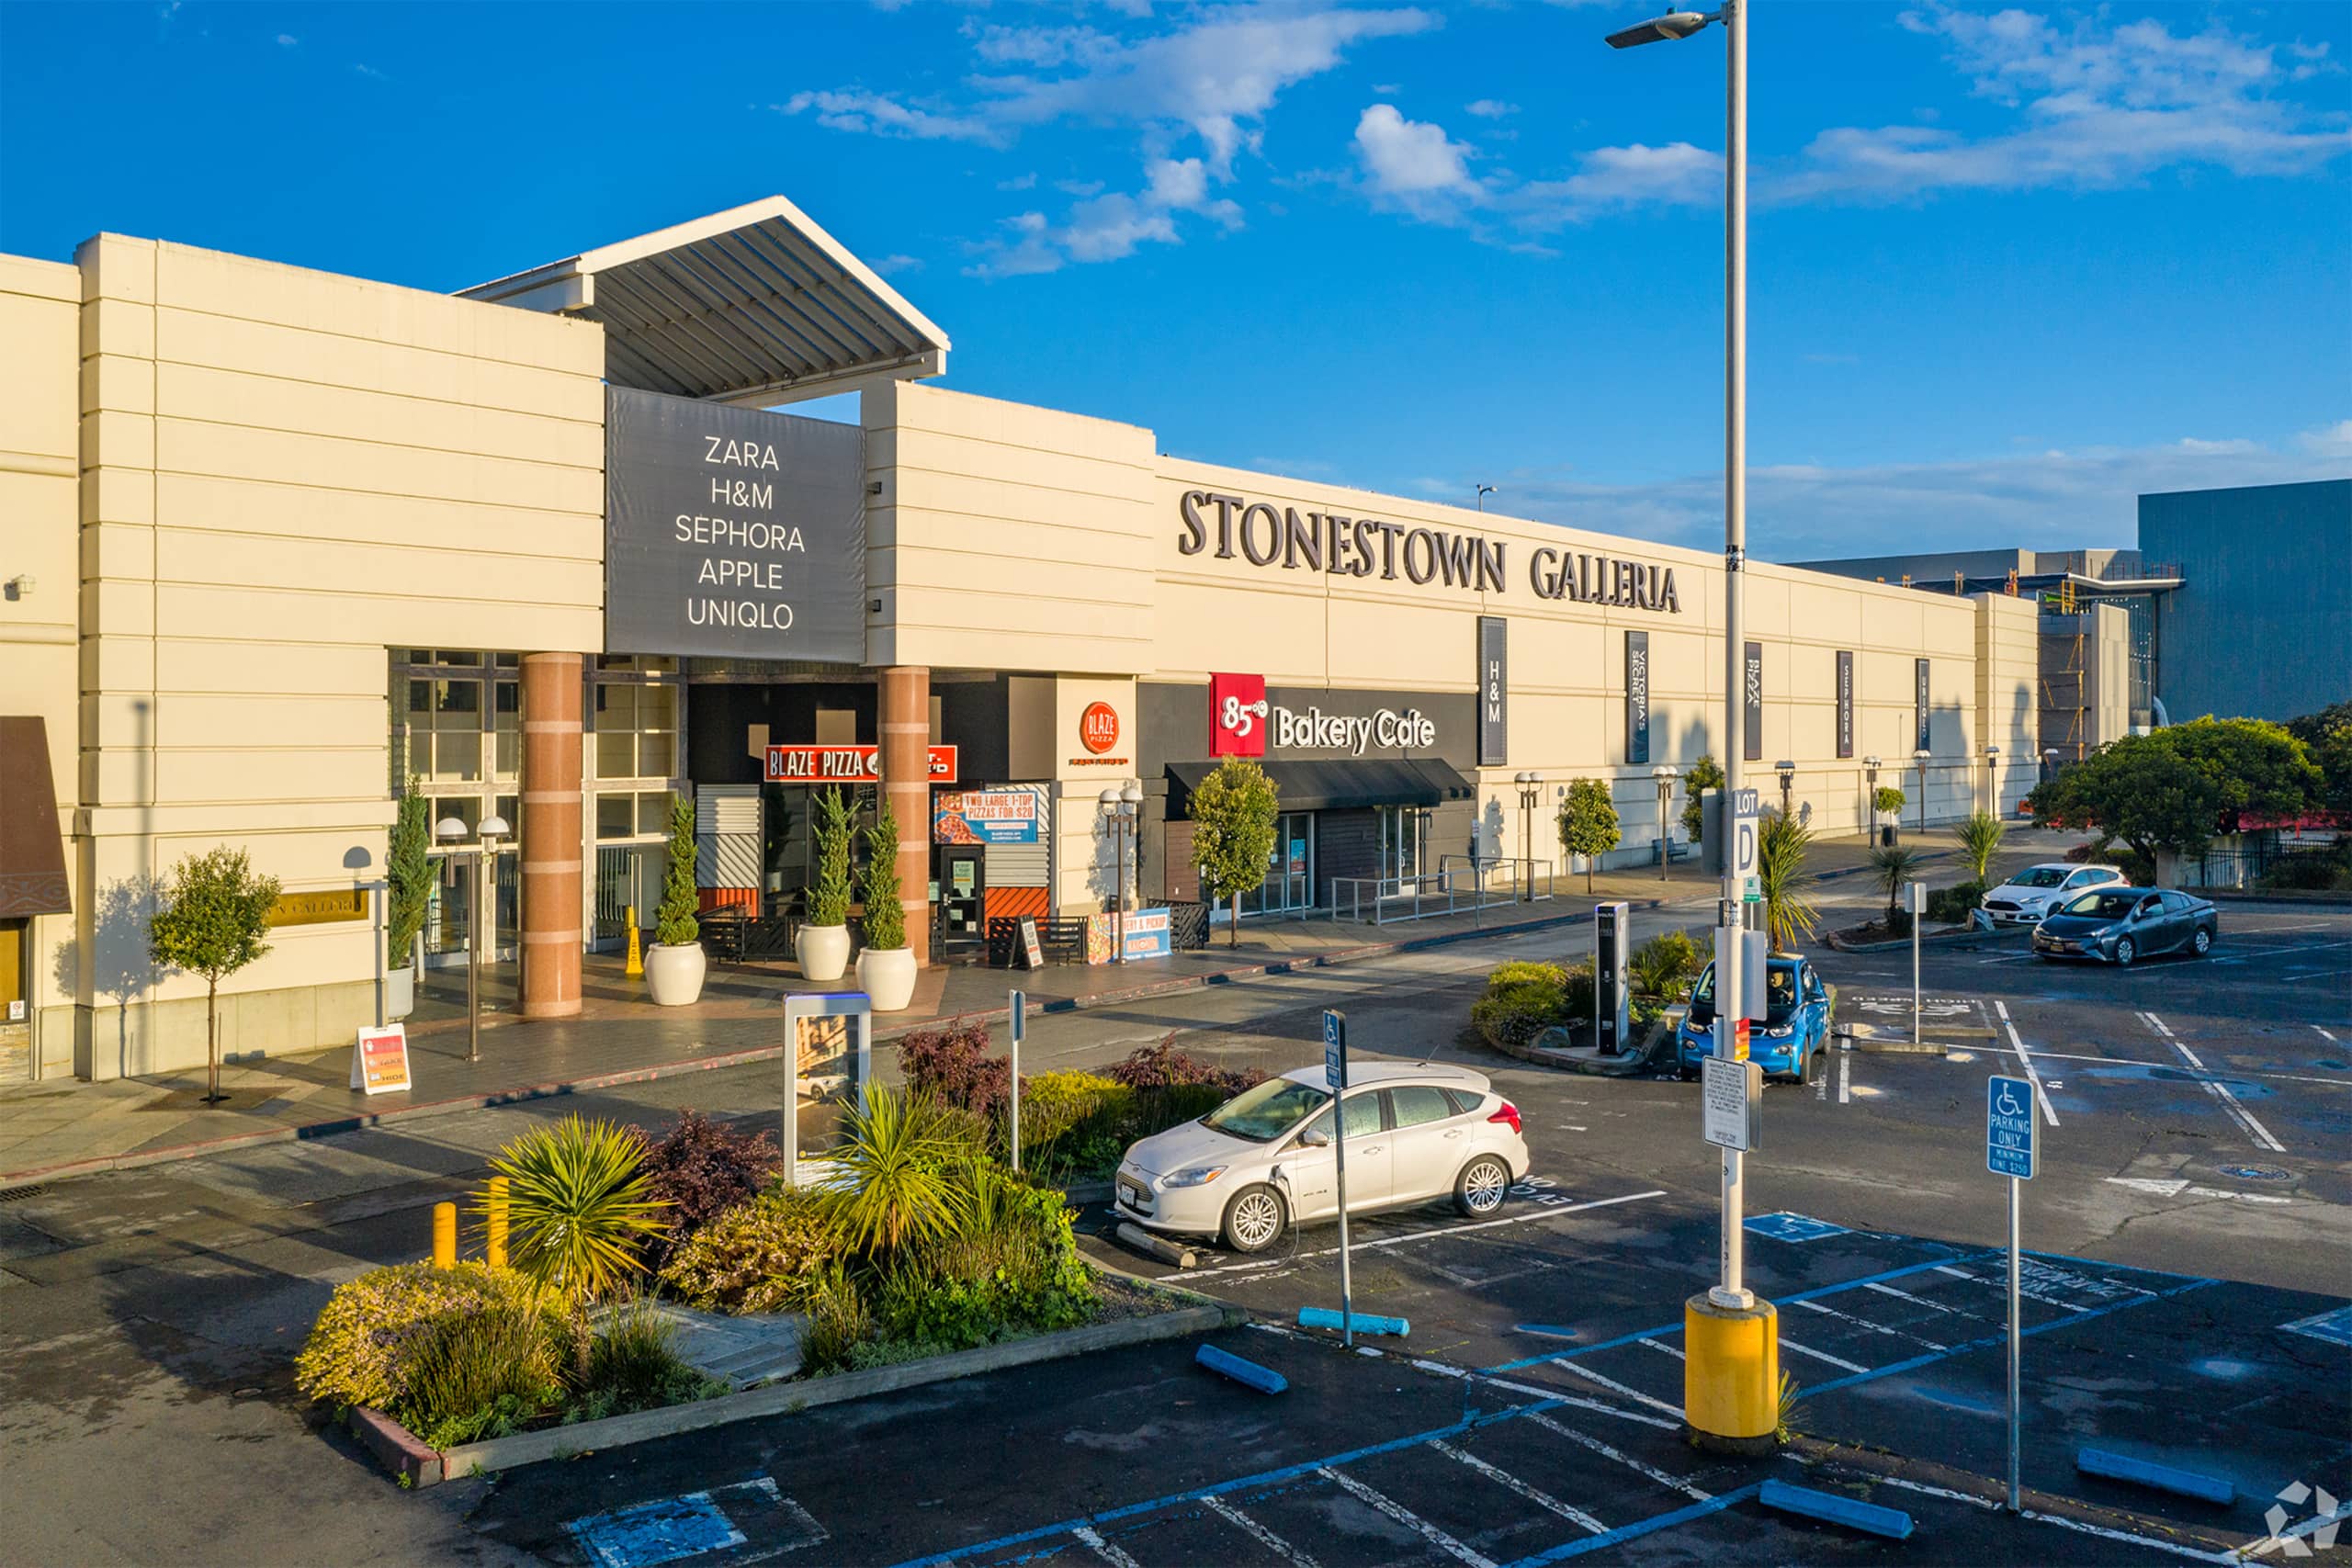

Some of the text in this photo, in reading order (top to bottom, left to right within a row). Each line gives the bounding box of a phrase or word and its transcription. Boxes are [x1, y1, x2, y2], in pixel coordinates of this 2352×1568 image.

[705, 435, 780, 470] ZARA
[711, 477, 773, 510] H&M
[675, 514, 806, 552] SEPHORA
[1179, 490, 1682, 614] STONESTOWN GALLERIA
[698, 558, 783, 590] APPLE
[688, 598, 794, 629] UNIQLO
[1632, 649, 1640, 704] SECRET
[1638, 650, 1646, 731] VICTORIA'S
[1843, 664, 1851, 745] SEPHORA
[1088, 713, 1114, 735] BLAZE
[1273, 706, 1435, 756] Bakery Cafe
[769, 750, 864, 776] BLAZE PIZZA
[966, 795, 982, 807] TWO
[985, 795, 1009, 807] LARGE
[968, 807, 1034, 818] PIZZAS FOR $20
[1736, 793, 1757, 814] LOT
[1739, 824, 1753, 871] D
[1990, 1113, 2030, 1134] PARKING
[1998, 1130, 2023, 1147] ONLY
[1992, 1157, 2029, 1175] FINE $250
[1996, 1148, 2024, 1163] MINIMUM
